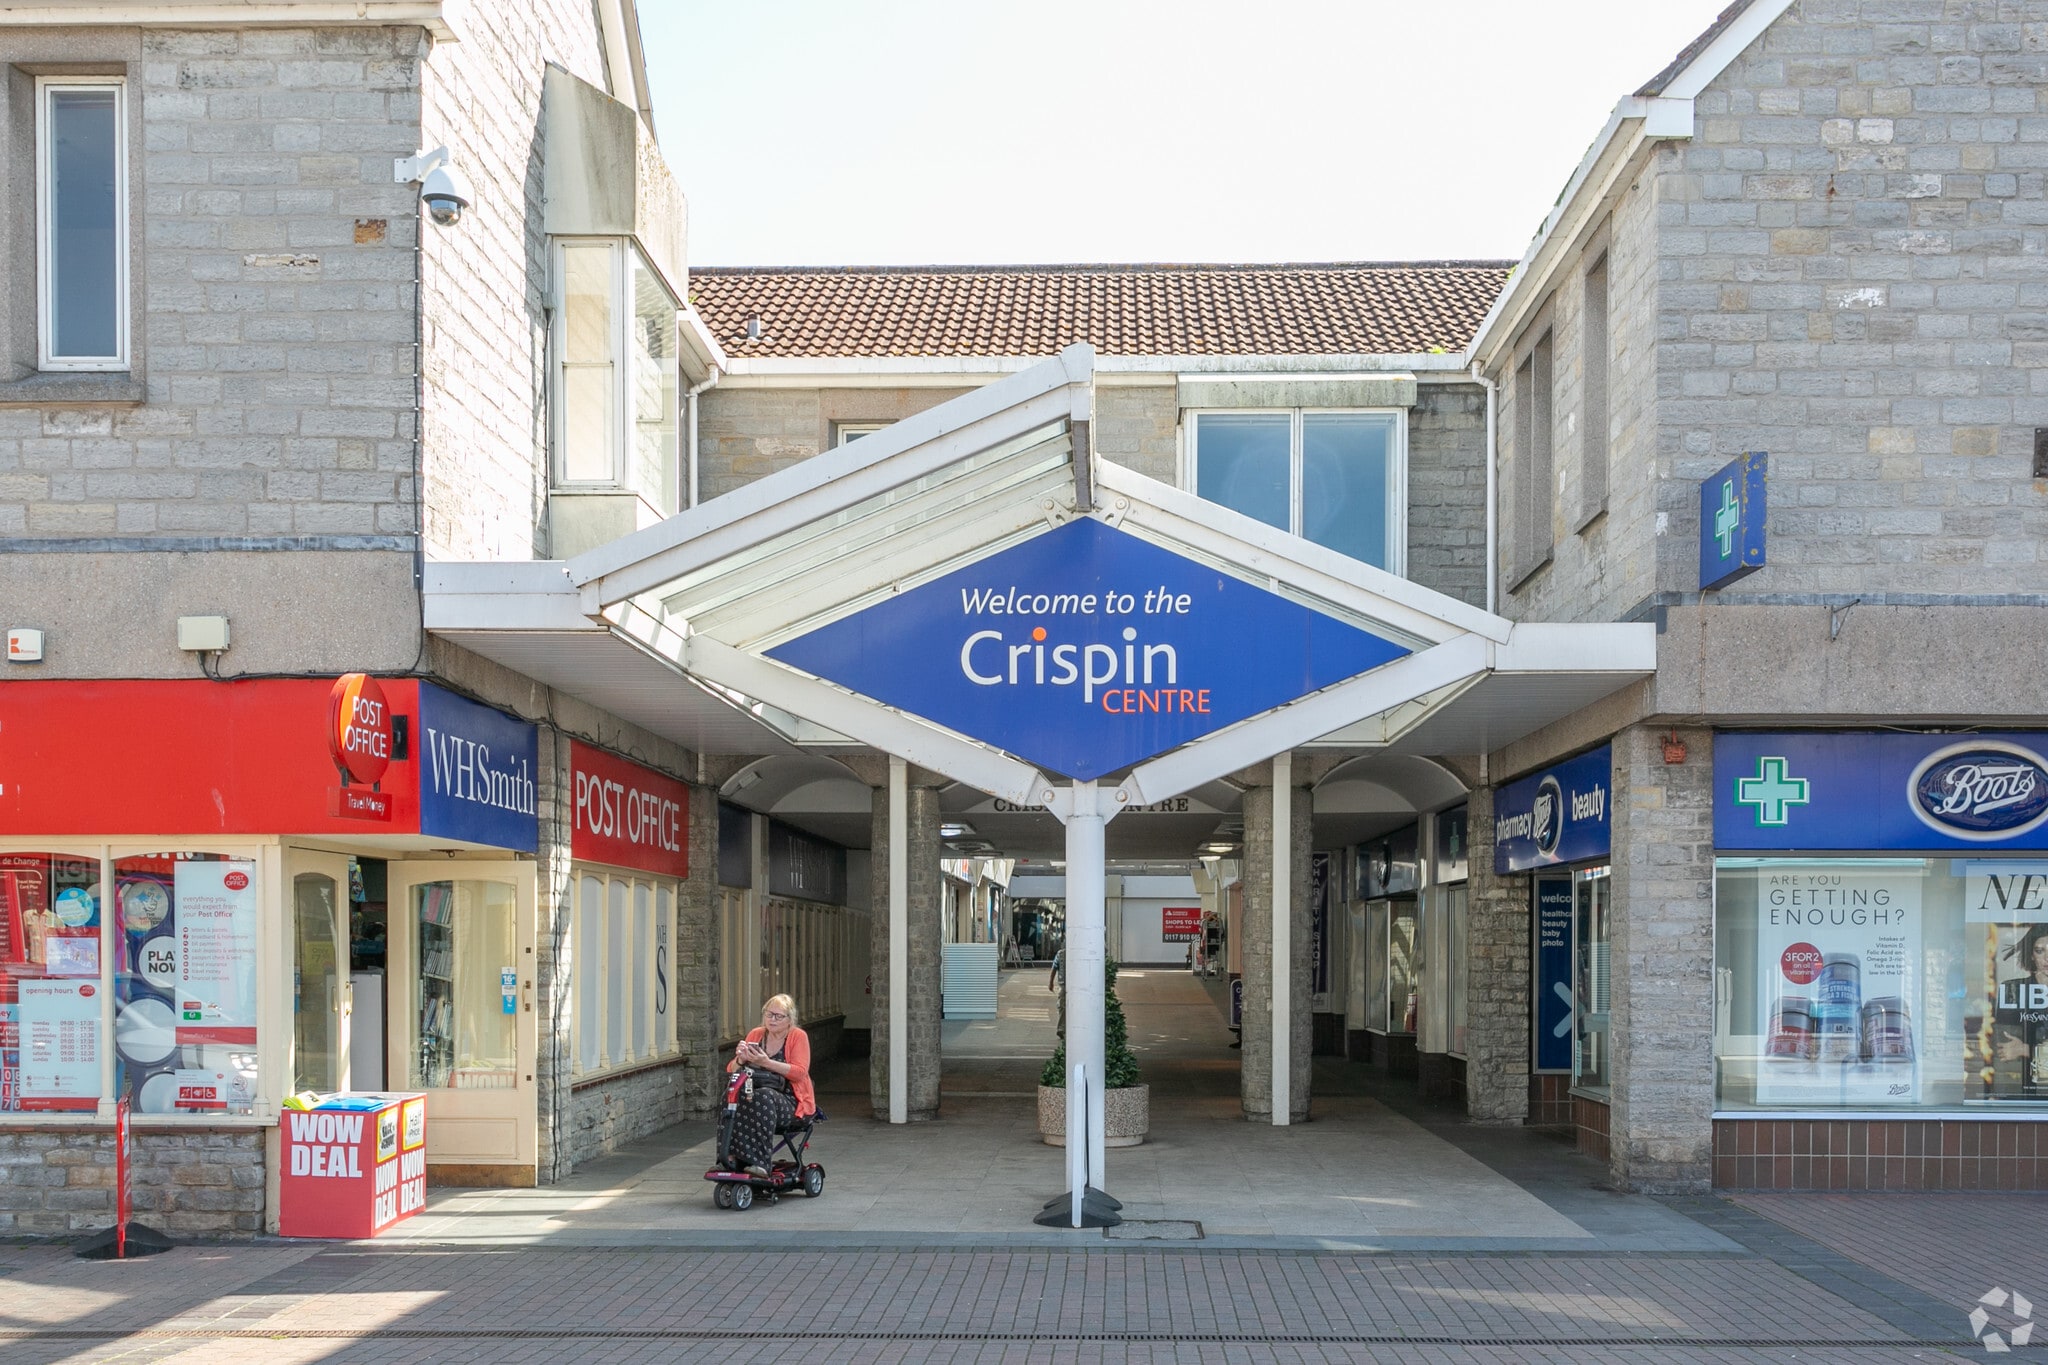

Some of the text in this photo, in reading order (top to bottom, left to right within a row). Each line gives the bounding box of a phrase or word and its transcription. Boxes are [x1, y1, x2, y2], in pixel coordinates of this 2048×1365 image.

[961, 585, 1192, 615] Welcome to the
[960, 626, 1178, 704] Crispin
[352, 695, 383, 728] POST
[1102, 689, 1212, 714] CENTRE
[345, 724, 388, 759] OFFICE
[427, 727, 536, 816] WHSmith
[1932, 764, 2036, 815] Boots
[575, 771, 680, 852] POST OFFICE
[1496, 810, 1532, 848] pharmacy
[1572, 783, 1605, 822] beauty
[13, 857, 40, 866] Change
[1770, 875, 1841, 885] ARE YOU
[202, 904, 222, 912] expect
[1770, 889, 1890, 905] GETTING
[1542, 919, 1567, 928] beauty
[1770, 908, 1905, 925] ENOUGH?
[1542, 929, 1560, 938] baby
[1542, 939, 1564, 948] photo
[147, 951, 175, 961] PLA
[26, 988, 53, 996] opening
[1998, 983, 2048, 1009] LIB
[290, 1113, 365, 1144] WOW
[290, 1145, 363, 1178] DEAL
[375, 1158, 398, 1195] WOW
[401, 1148, 425, 1182] WOW
[374, 1189, 398, 1230] DEAL
[401, 1177, 425, 1214] DEAL
